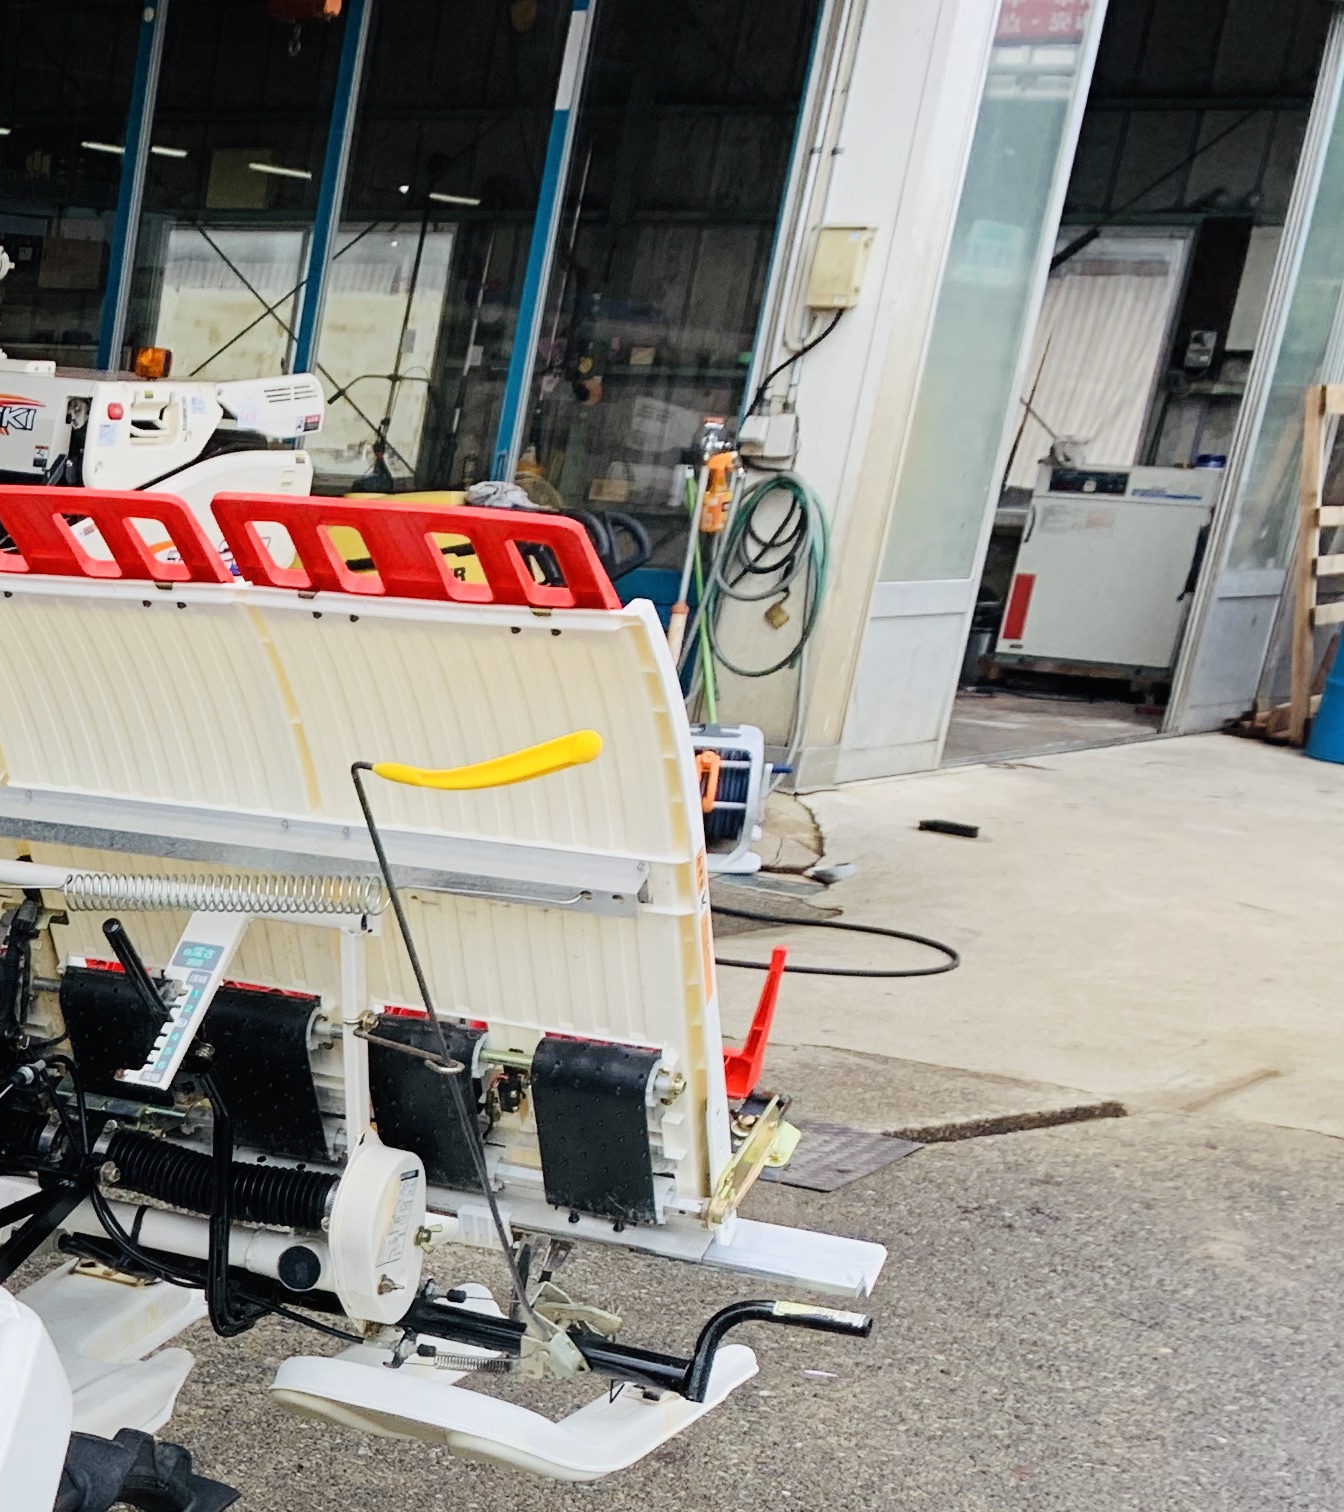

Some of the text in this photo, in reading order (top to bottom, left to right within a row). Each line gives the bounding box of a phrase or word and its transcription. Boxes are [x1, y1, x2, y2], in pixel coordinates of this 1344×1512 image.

[184, 1004, 194, 1013] 2
[171, 1033, 180, 1041] 4
[157, 1061, 166, 1069] 6
